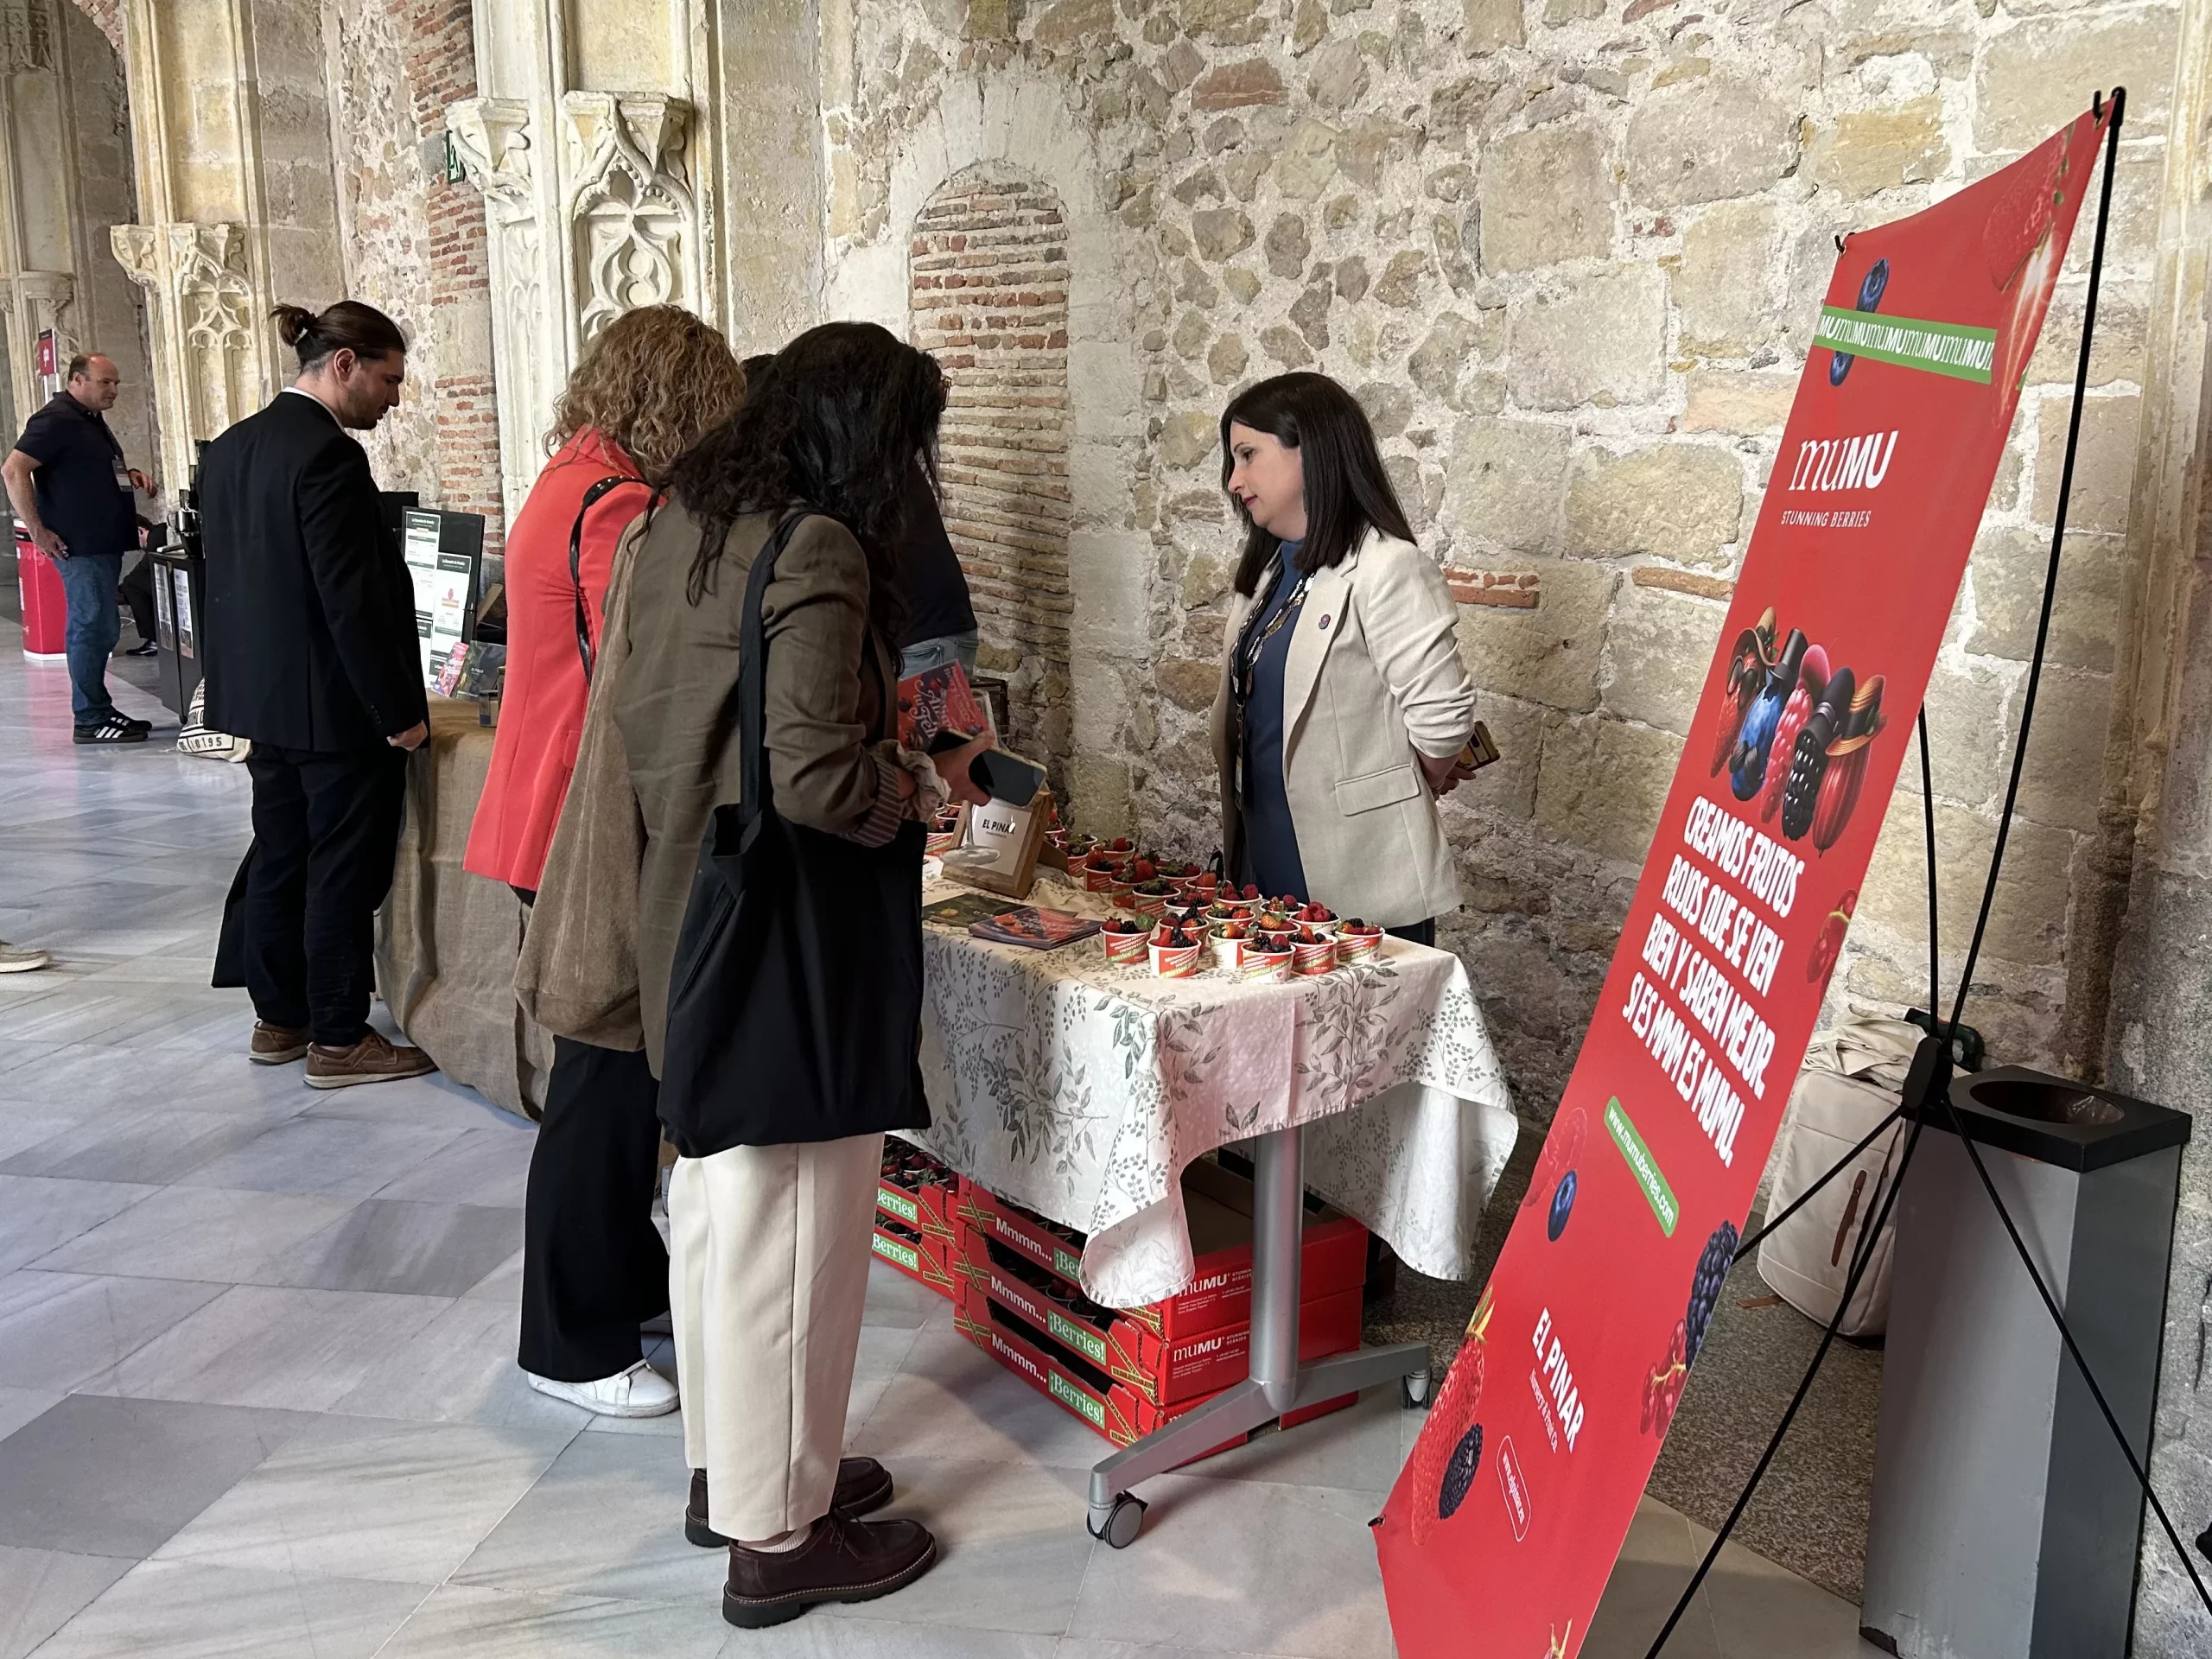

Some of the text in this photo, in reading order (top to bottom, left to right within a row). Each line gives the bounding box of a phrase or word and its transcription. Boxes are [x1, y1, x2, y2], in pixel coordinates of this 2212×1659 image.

[1781, 510, 1872, 527] STUNNING BERRIES
[1788, 430, 1899, 492] muMU
[982, 818, 990, 830] EL
[1684, 796, 1805, 918] CREAMOS FRUTOS
[1662, 854, 1784, 997] ROJOS QUE SE VEN
[1642, 912, 1776, 1100] BIEN Y SABEN MEJOR.
[1623, 972, 1745, 1168] SI ES MMM ES MUMU.
[1608, 1106, 1675, 1228] www.mumuberries.com
[1049, 1313, 1105, 1363] ¡Berries!
[1051, 1372, 1104, 1425] ¡Berries!
[1532, 1306, 1584, 1453] EL PINAR
